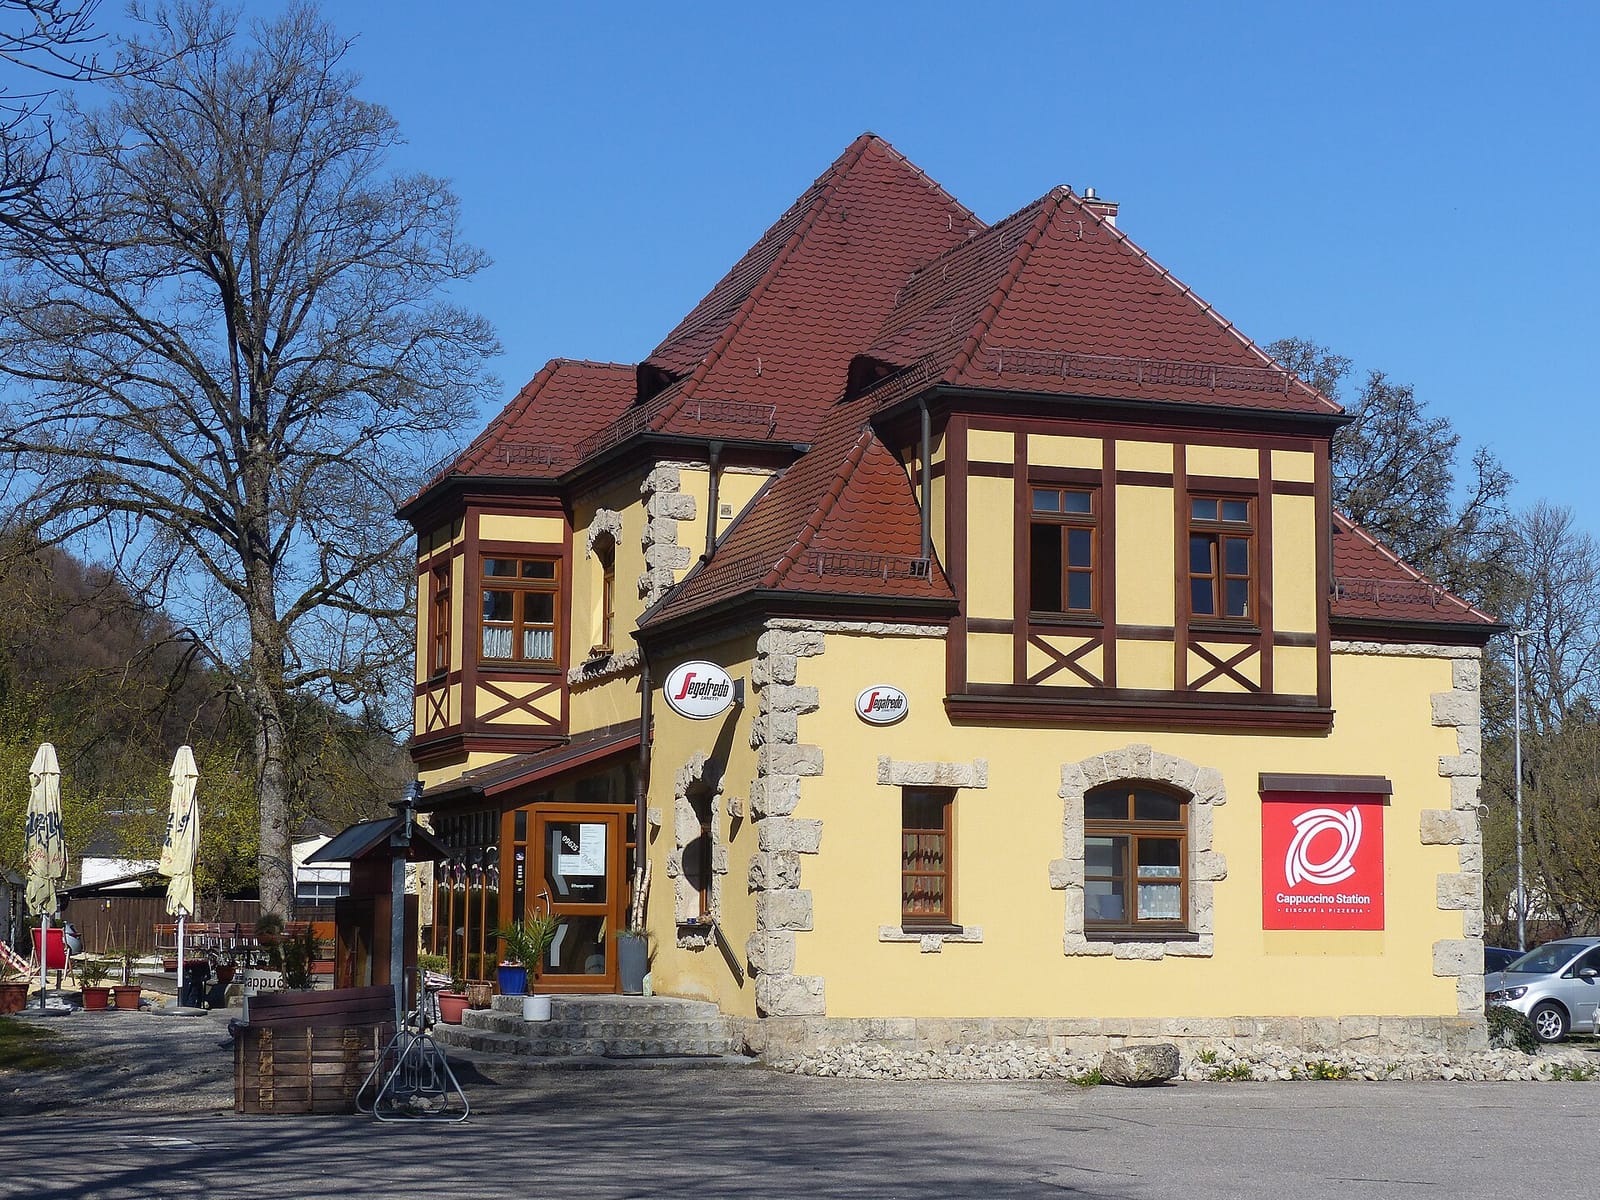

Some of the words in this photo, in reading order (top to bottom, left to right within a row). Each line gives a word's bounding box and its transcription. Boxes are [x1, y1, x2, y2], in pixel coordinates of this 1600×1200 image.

[674, 672, 729, 700] Segafredo
[864, 691, 903, 713] Segafredo
[1276, 893, 1335, 905] Cappuccino
[1336, 893, 1371, 904] Station
